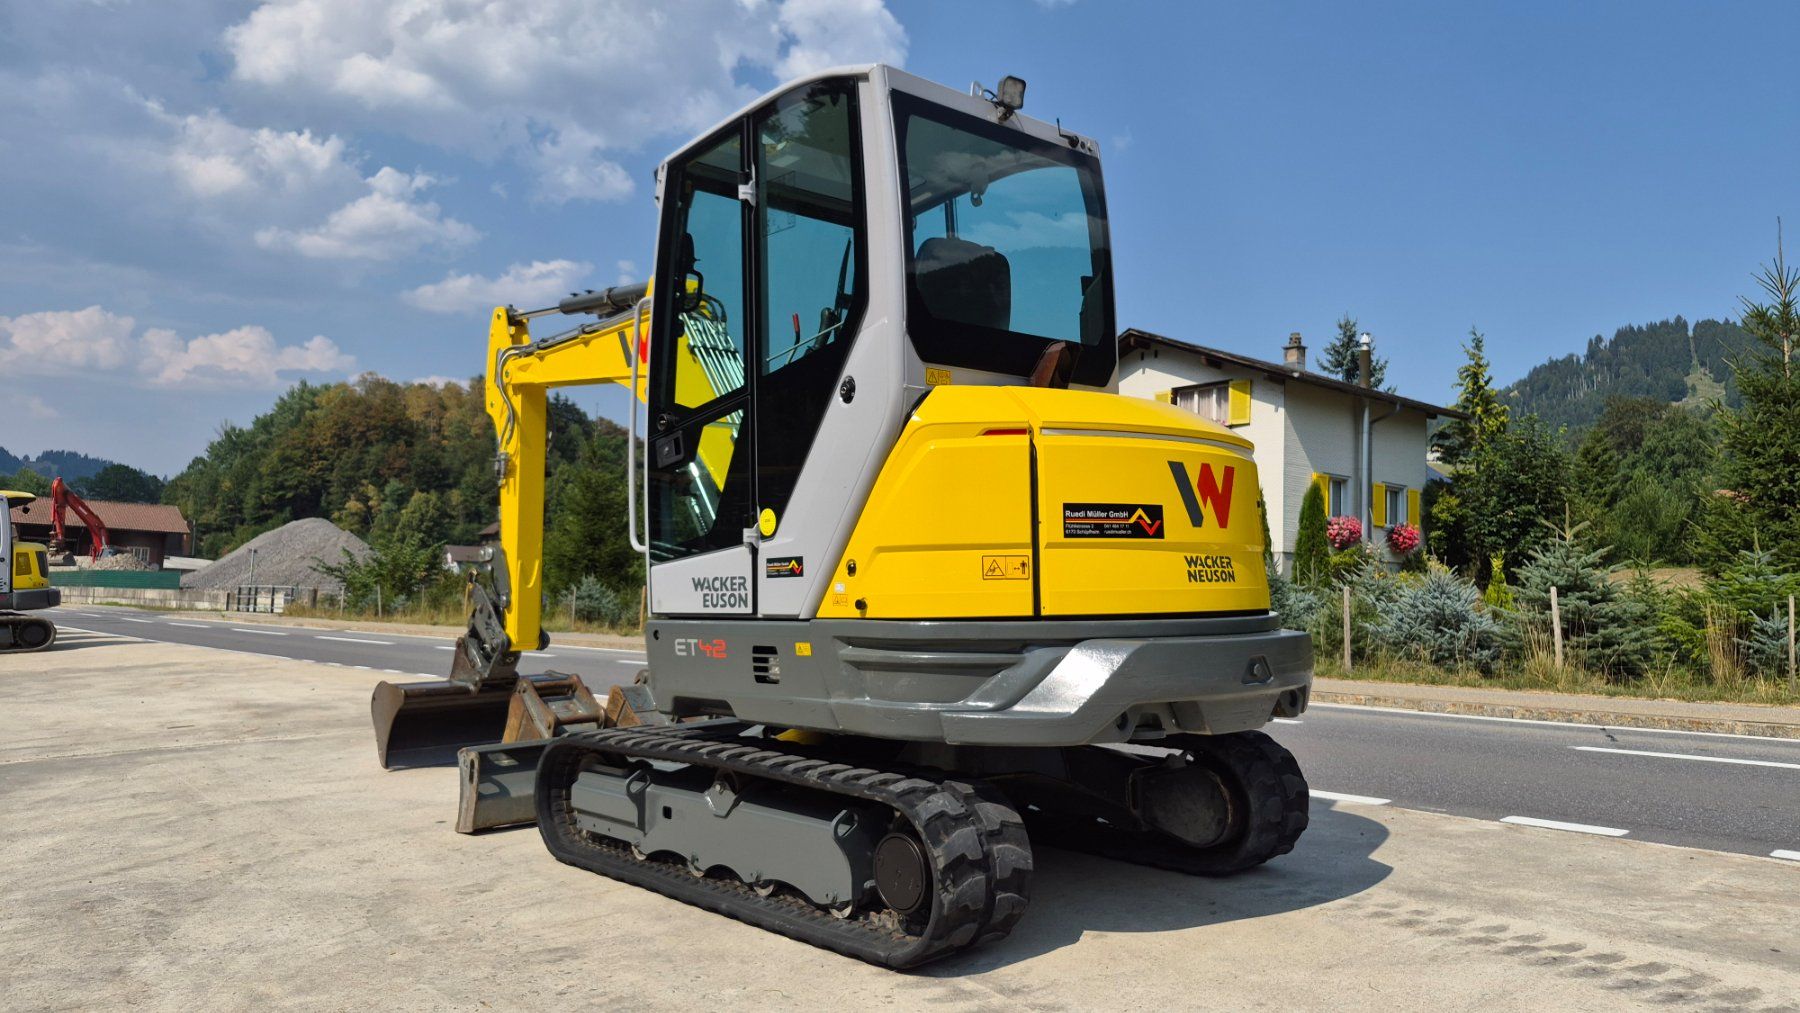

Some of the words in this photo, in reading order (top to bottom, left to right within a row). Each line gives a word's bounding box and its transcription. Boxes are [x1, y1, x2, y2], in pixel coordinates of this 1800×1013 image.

[1167, 460, 1235, 529] W
[1086, 510, 1108, 518] Müller
[1184, 555, 1233, 569] WACKER
[1187, 569, 1236, 583] NEUSON
[692, 576, 748, 592] WACKER
[703, 593, 748, 609] EUSON
